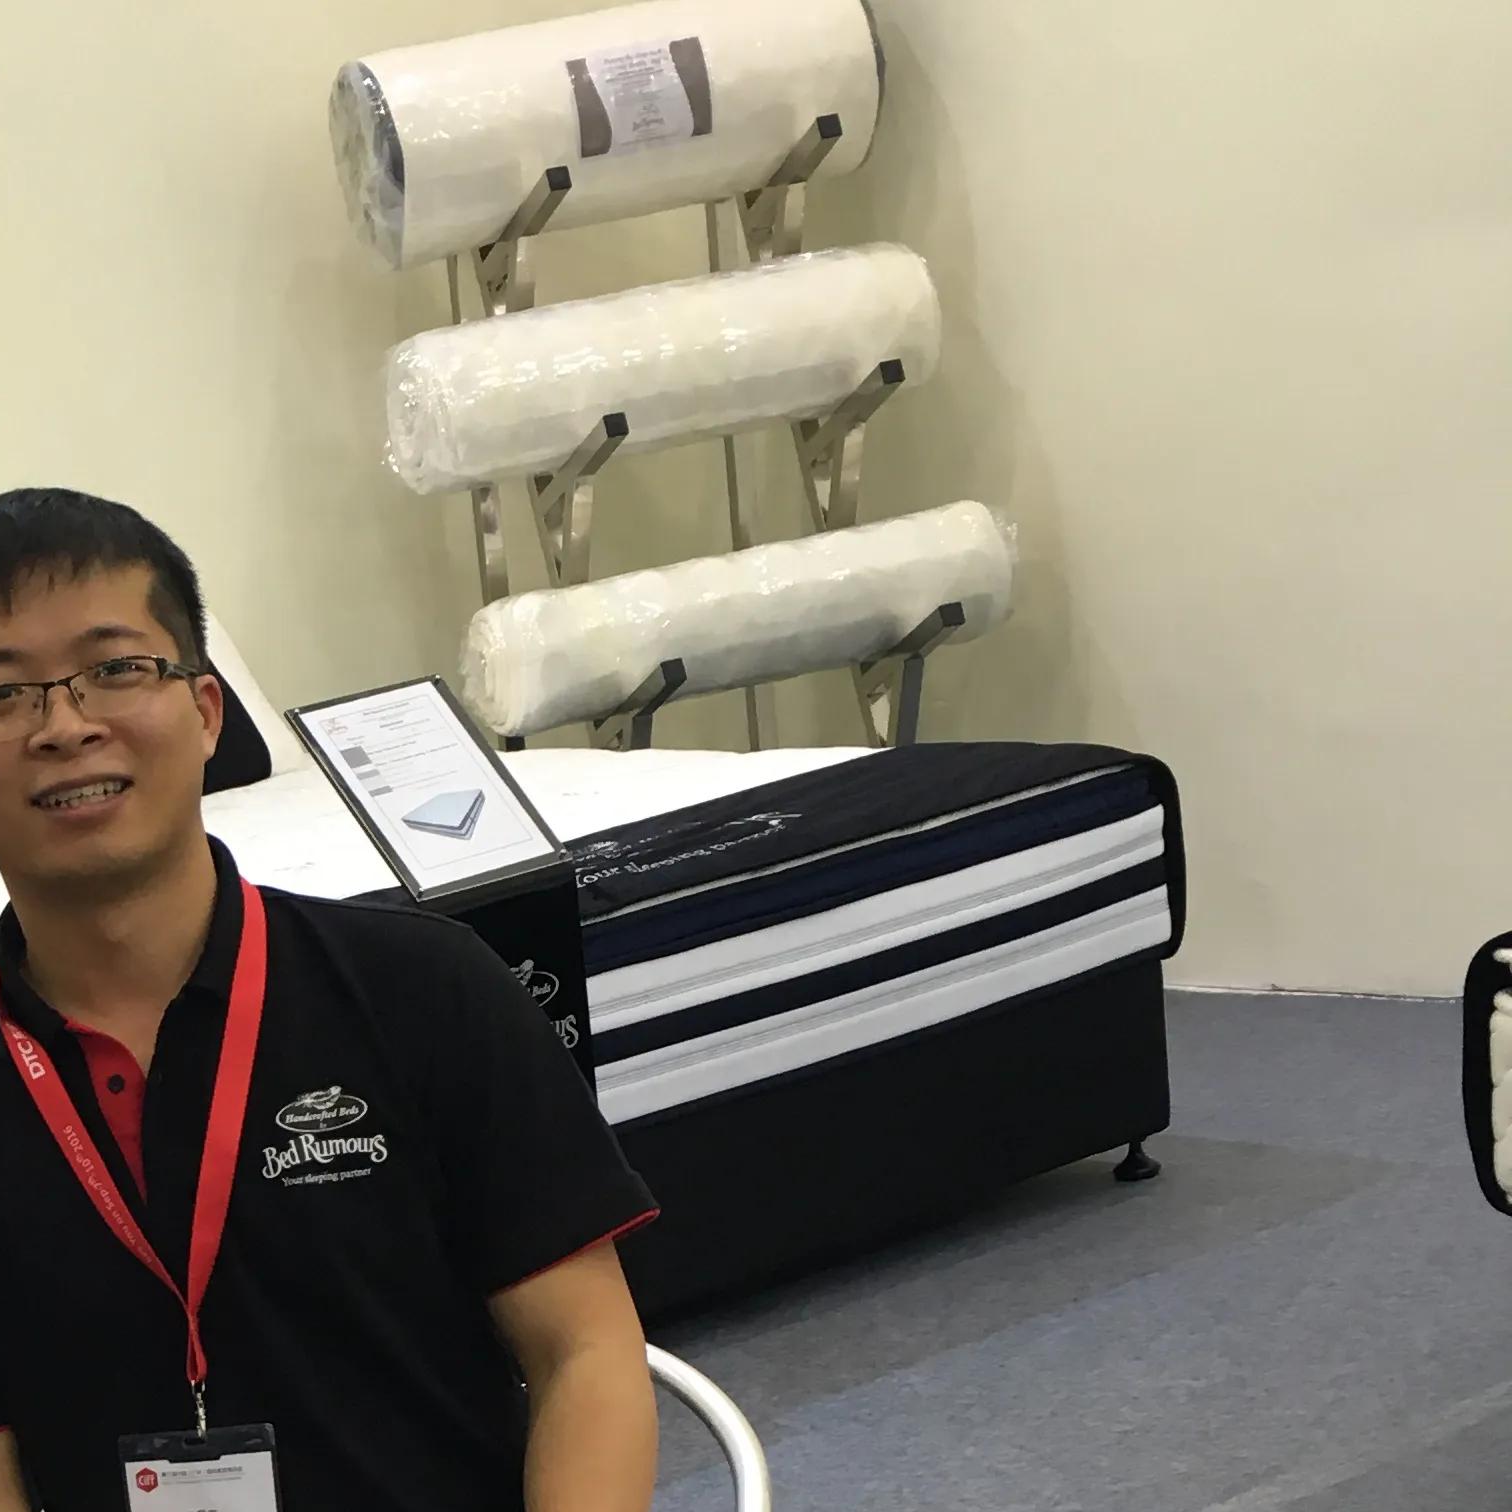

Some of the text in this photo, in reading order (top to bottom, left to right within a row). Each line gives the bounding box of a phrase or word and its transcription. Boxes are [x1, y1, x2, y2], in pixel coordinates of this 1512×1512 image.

[262, 1133, 388, 1179] Bed Rumours
[282, 1176, 303, 1187] Your
